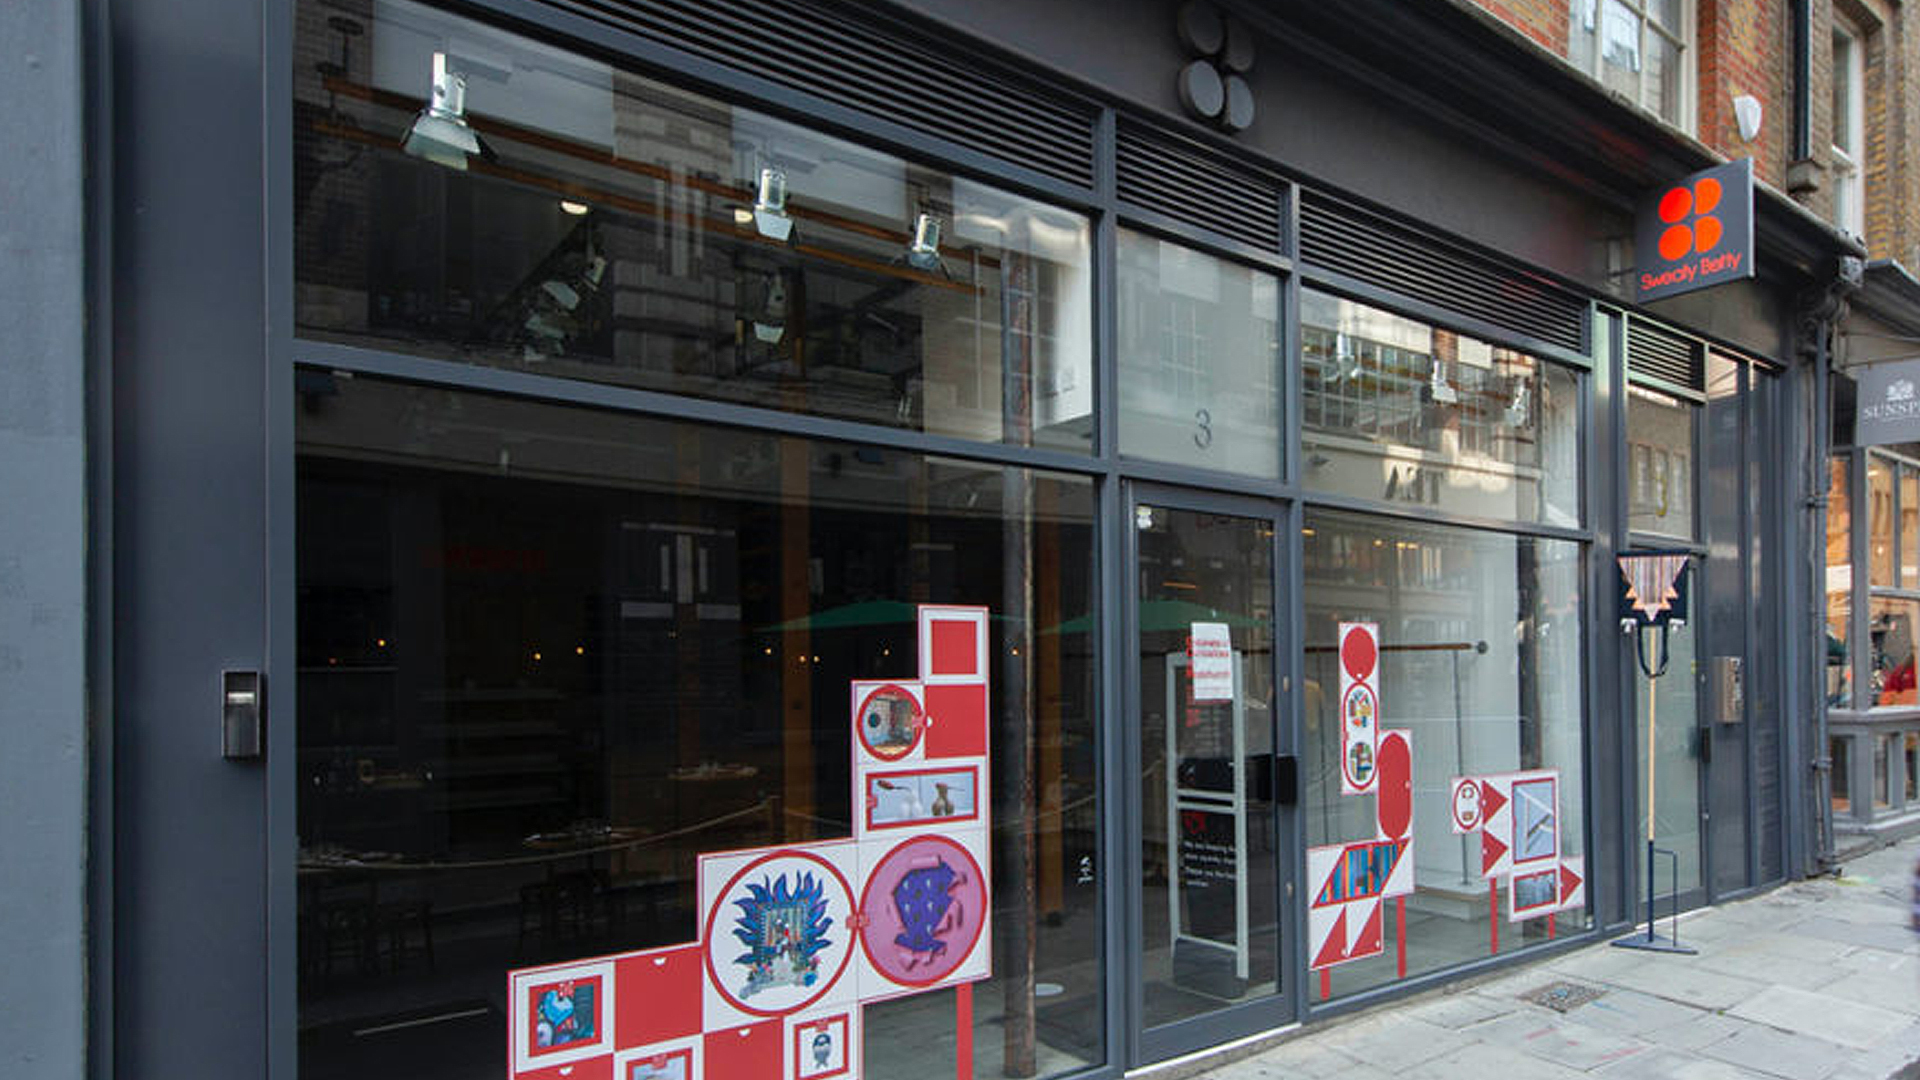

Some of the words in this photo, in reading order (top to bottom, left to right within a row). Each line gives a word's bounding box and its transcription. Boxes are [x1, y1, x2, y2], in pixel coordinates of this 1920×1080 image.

[1640, 263, 1697, 290] Sweaty
[1700, 252, 1742, 276] Betty
[1193, 408, 1213, 450] 3
[1862, 400, 1920, 421] SUNSP
